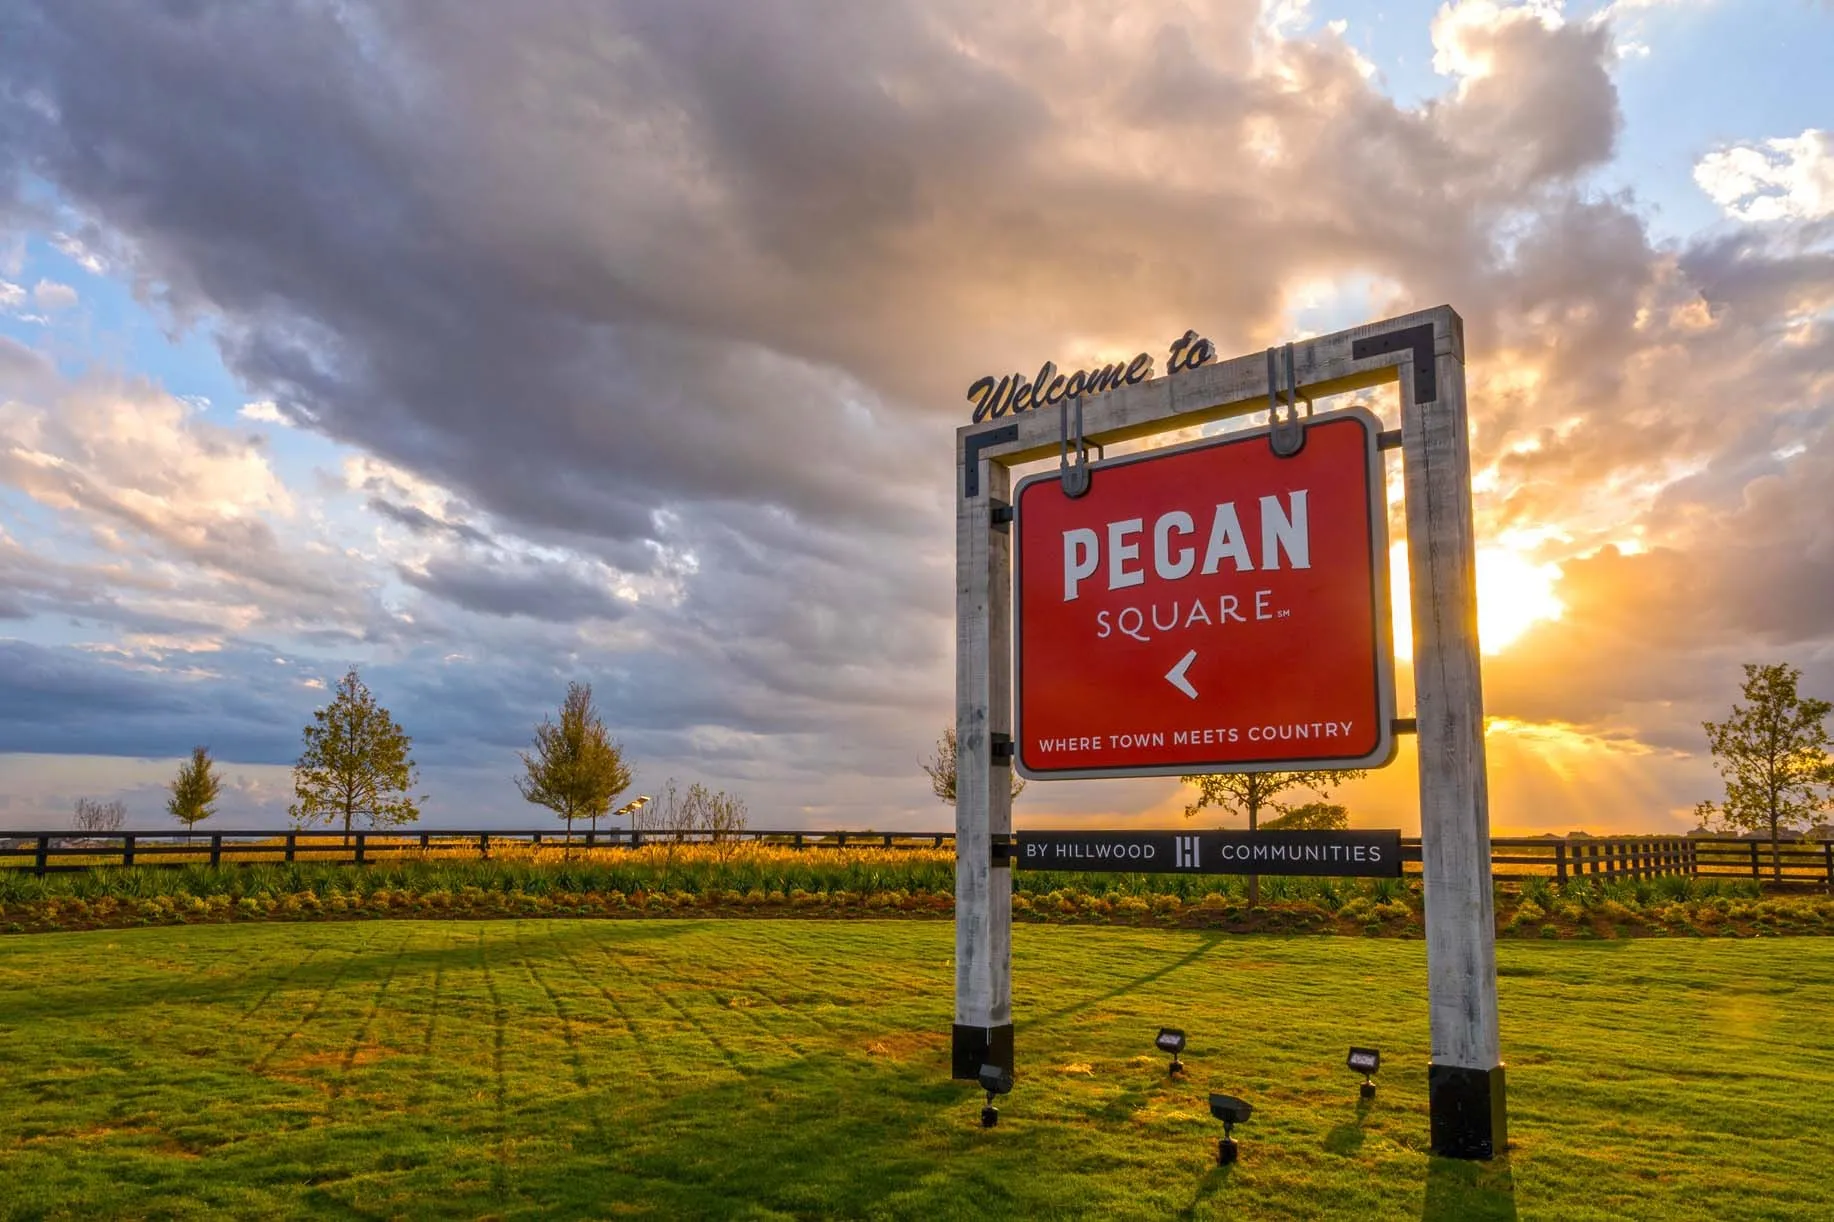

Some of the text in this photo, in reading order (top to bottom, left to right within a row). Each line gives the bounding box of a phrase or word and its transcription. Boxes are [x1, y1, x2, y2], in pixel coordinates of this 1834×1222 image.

[966, 329, 1217, 423] Welcome to
[1062, 488, 1310, 602] PECAN
[1097, 590, 1273, 641] SQUARE
[1038, 721, 1354, 753] WHERE TOWN MEETS COUNTRY
[1026, 843, 1048, 858] BY
[1055, 843, 1156, 859] HILLWOOD
[1221, 844, 1382, 863] COMMUNITIES
